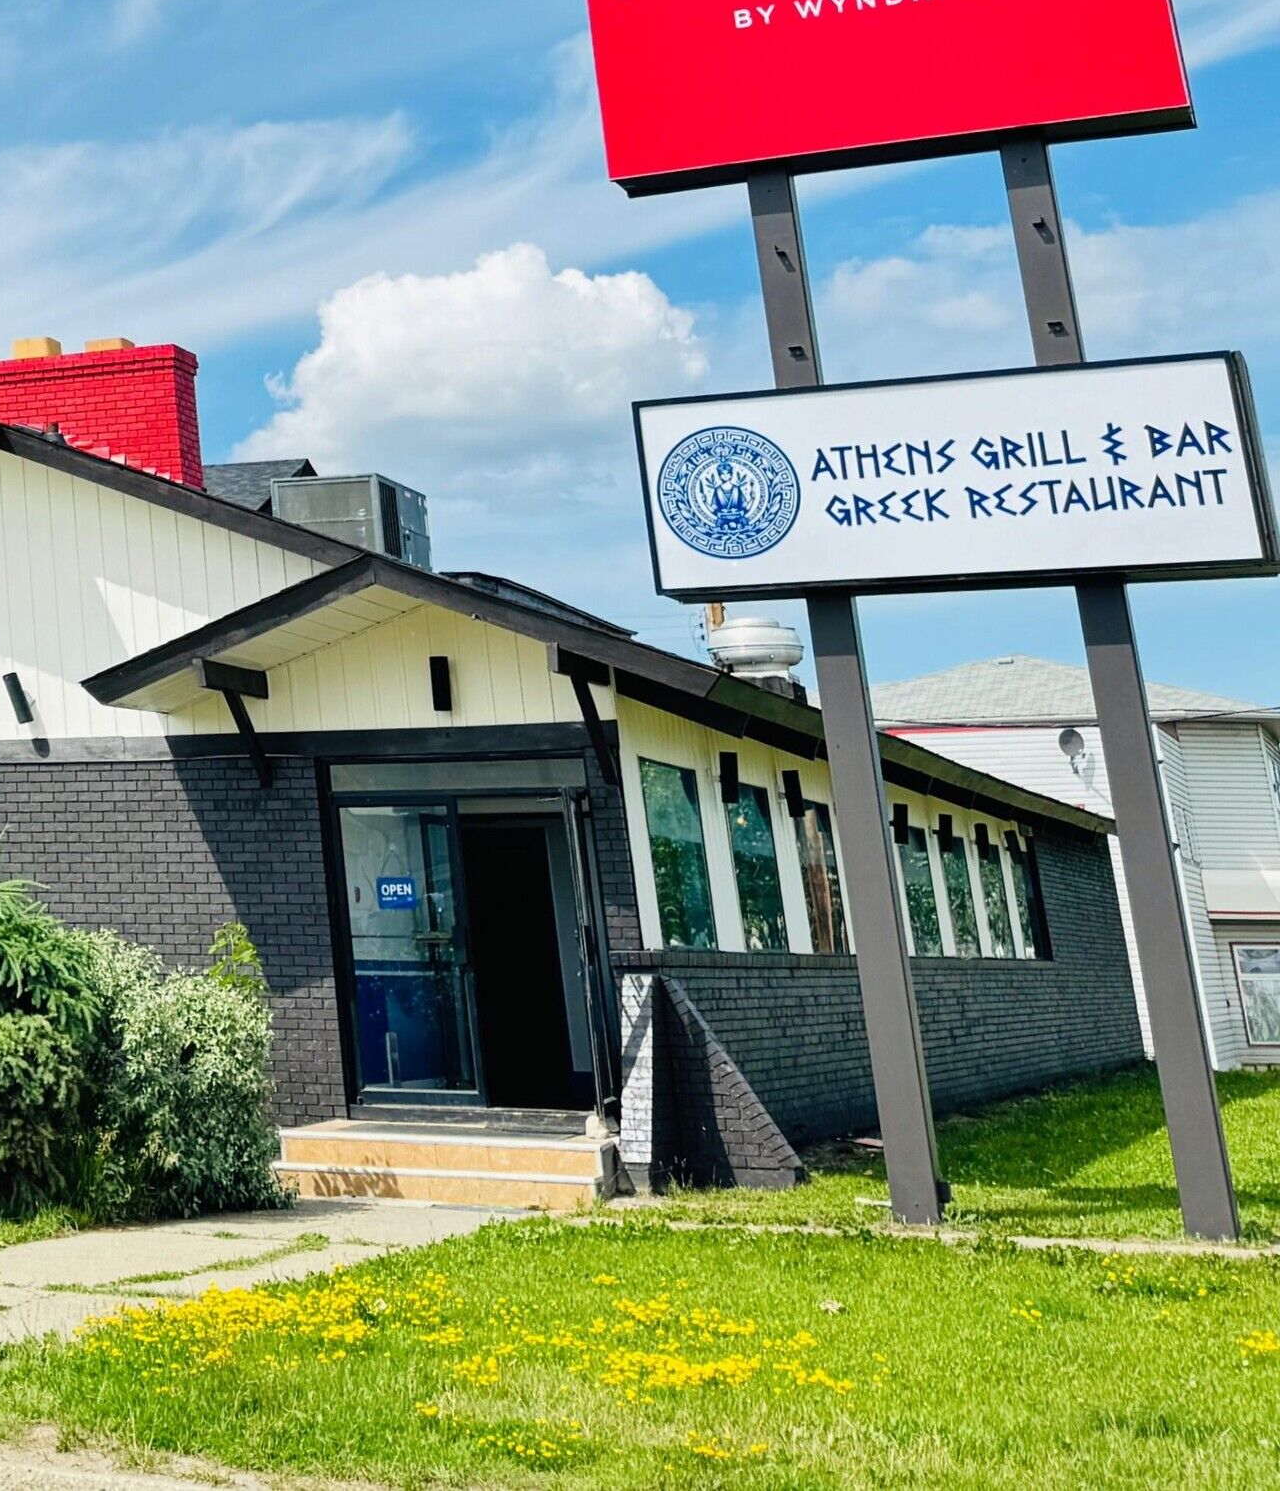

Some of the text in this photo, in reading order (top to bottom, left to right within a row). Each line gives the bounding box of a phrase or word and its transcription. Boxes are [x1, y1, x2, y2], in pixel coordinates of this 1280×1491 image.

[733, 4, 775, 29] BY
[811, 439, 956, 482] ATHENS
[970, 429, 1087, 471] GRILL
[1143, 420, 1233, 459] BAR
[824, 468, 1228, 527] GREEK RESTAURANT
[380, 883, 412, 896] OPEN
